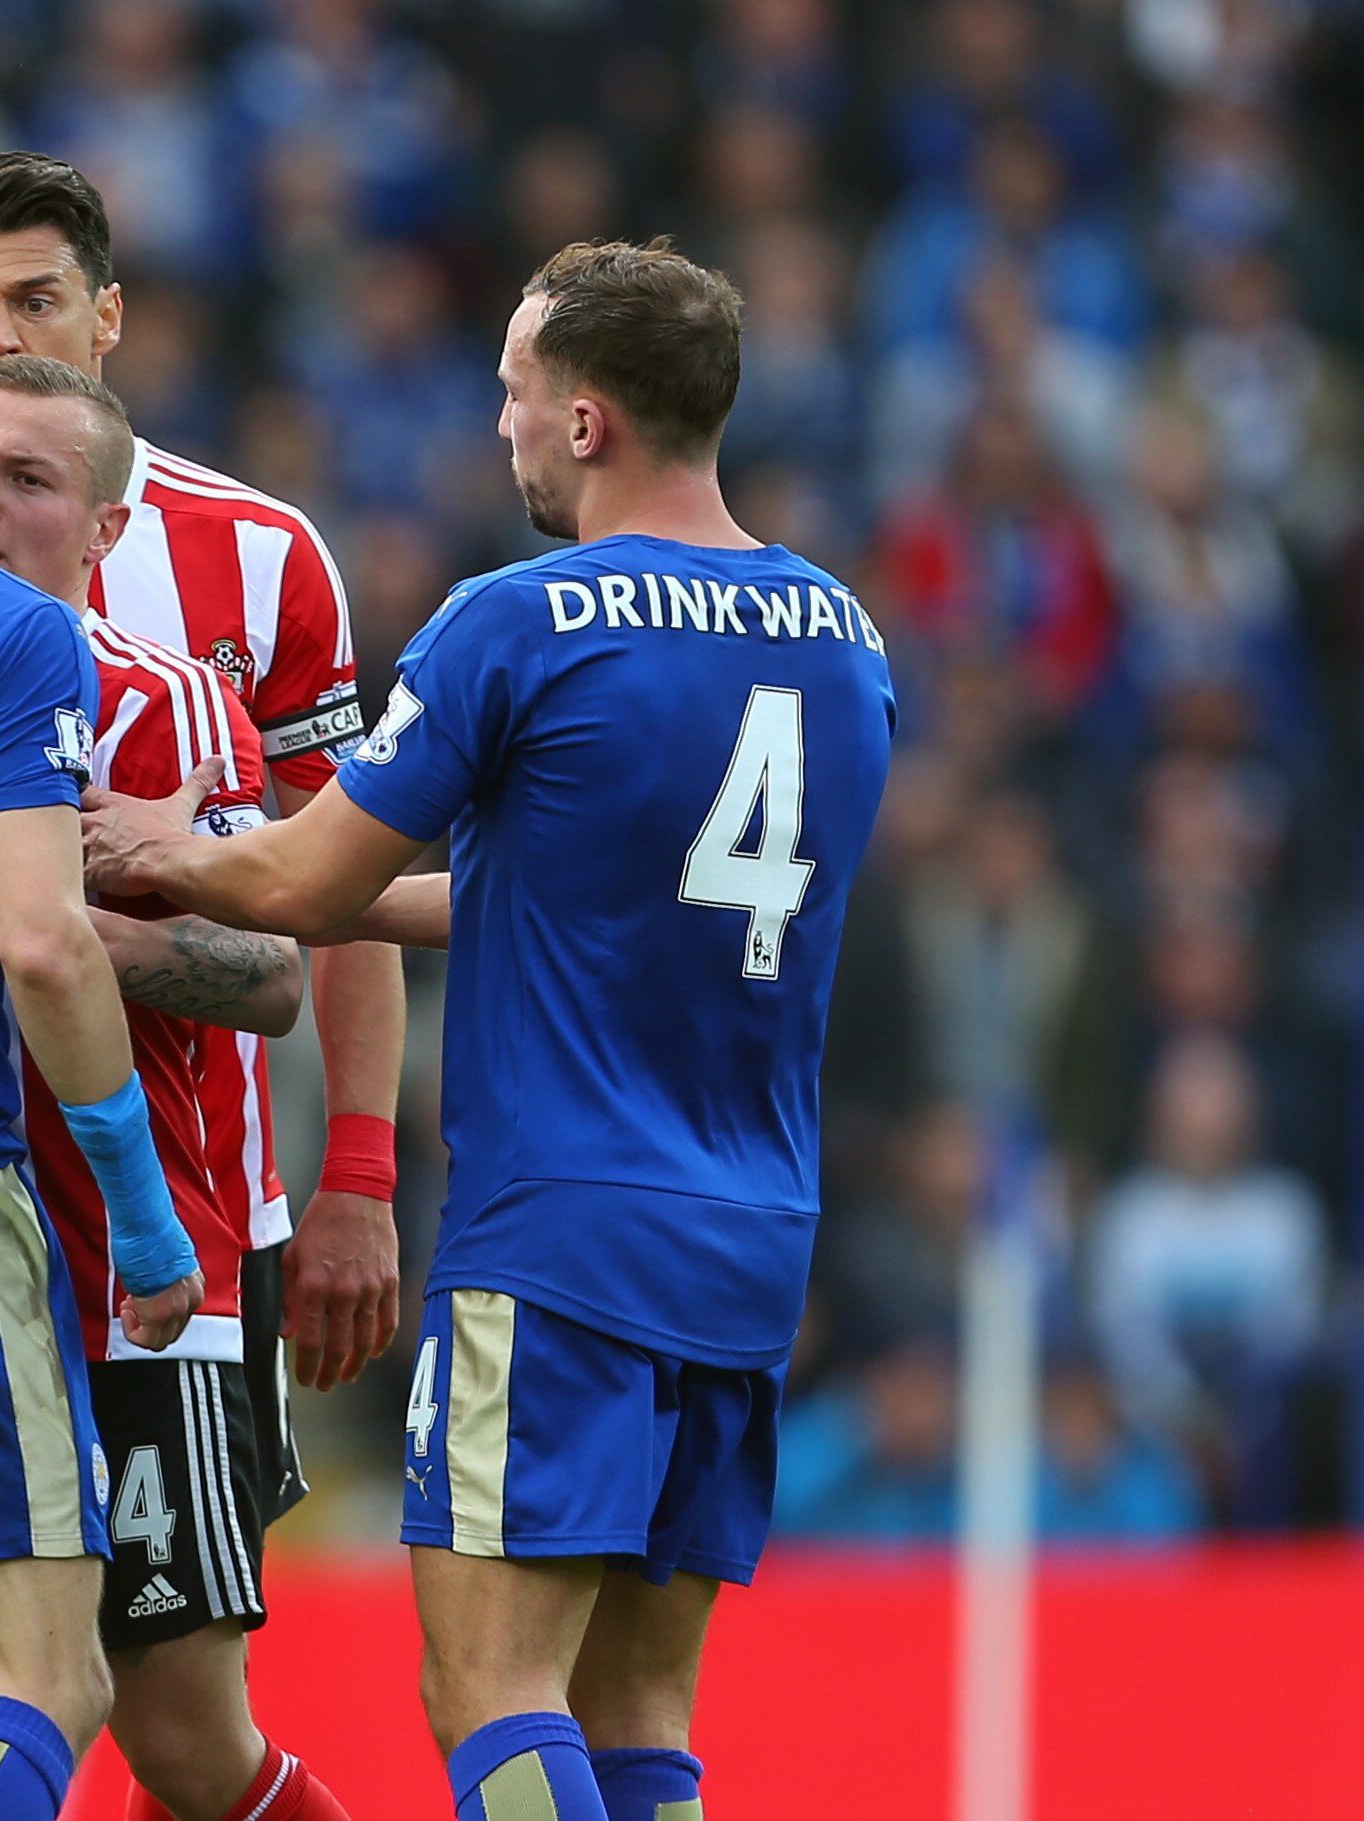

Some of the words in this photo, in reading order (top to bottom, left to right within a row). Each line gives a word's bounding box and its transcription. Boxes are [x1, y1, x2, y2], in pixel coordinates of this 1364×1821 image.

[678, 684, 816, 981] 4
[406, 1336, 439, 1457] 4
[111, 1445, 177, 1565] 4
[128, 1594, 187, 1618] adidas
